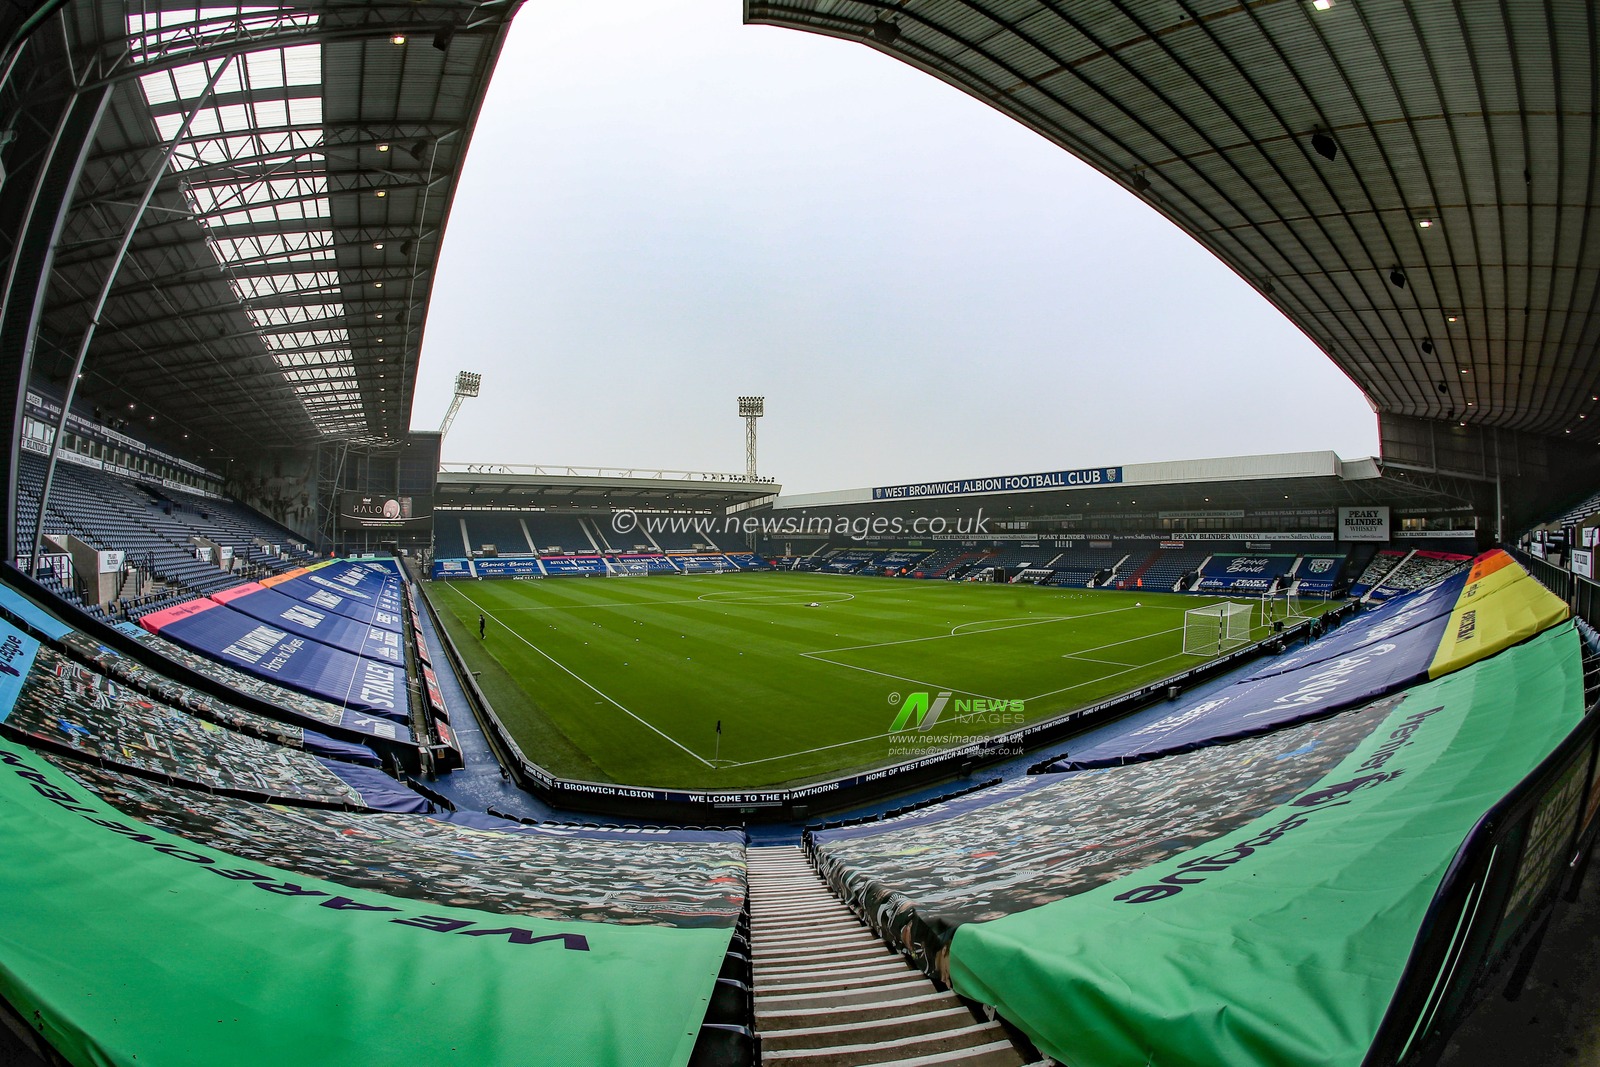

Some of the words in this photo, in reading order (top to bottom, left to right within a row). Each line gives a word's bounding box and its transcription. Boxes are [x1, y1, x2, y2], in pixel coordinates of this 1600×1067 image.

[884, 486, 908, 498] WEST
[909, 482, 960, 496] BROMWICH
[962, 478, 1001, 492] ALBION
[1005, 472, 1065, 489] FOOTBALL
[1067, 470, 1101, 485] CLUB
[353, 505, 382, 514] HALO
[1349, 510, 1379, 518] PEAKY
[1345, 518, 1383, 526] BLINDER
[1082, 708, 1094, 716] HOME
[1100, 702, 1110, 710] WEST
[1042, 716, 1070, 729] HAWTHORNS
[1358, 705, 1445, 774] Premier
[865, 770, 887, 782] HOME
[888, 767, 898, 776] OF
[899, 762, 918, 773] WEST
[920, 752, 955, 767] BROMWICH
[525, 765, 537, 776] HOME
[564, 782, 615, 795] BROMWICH
[617, 789, 655, 799] ALBION
[688, 794, 741, 803] WELCOME
[744, 794, 757, 802] TO
[783, 782, 839, 801] HAWTHORNS
[207, 868, 403, 912] ARE
[389, 914, 591, 952] WE
